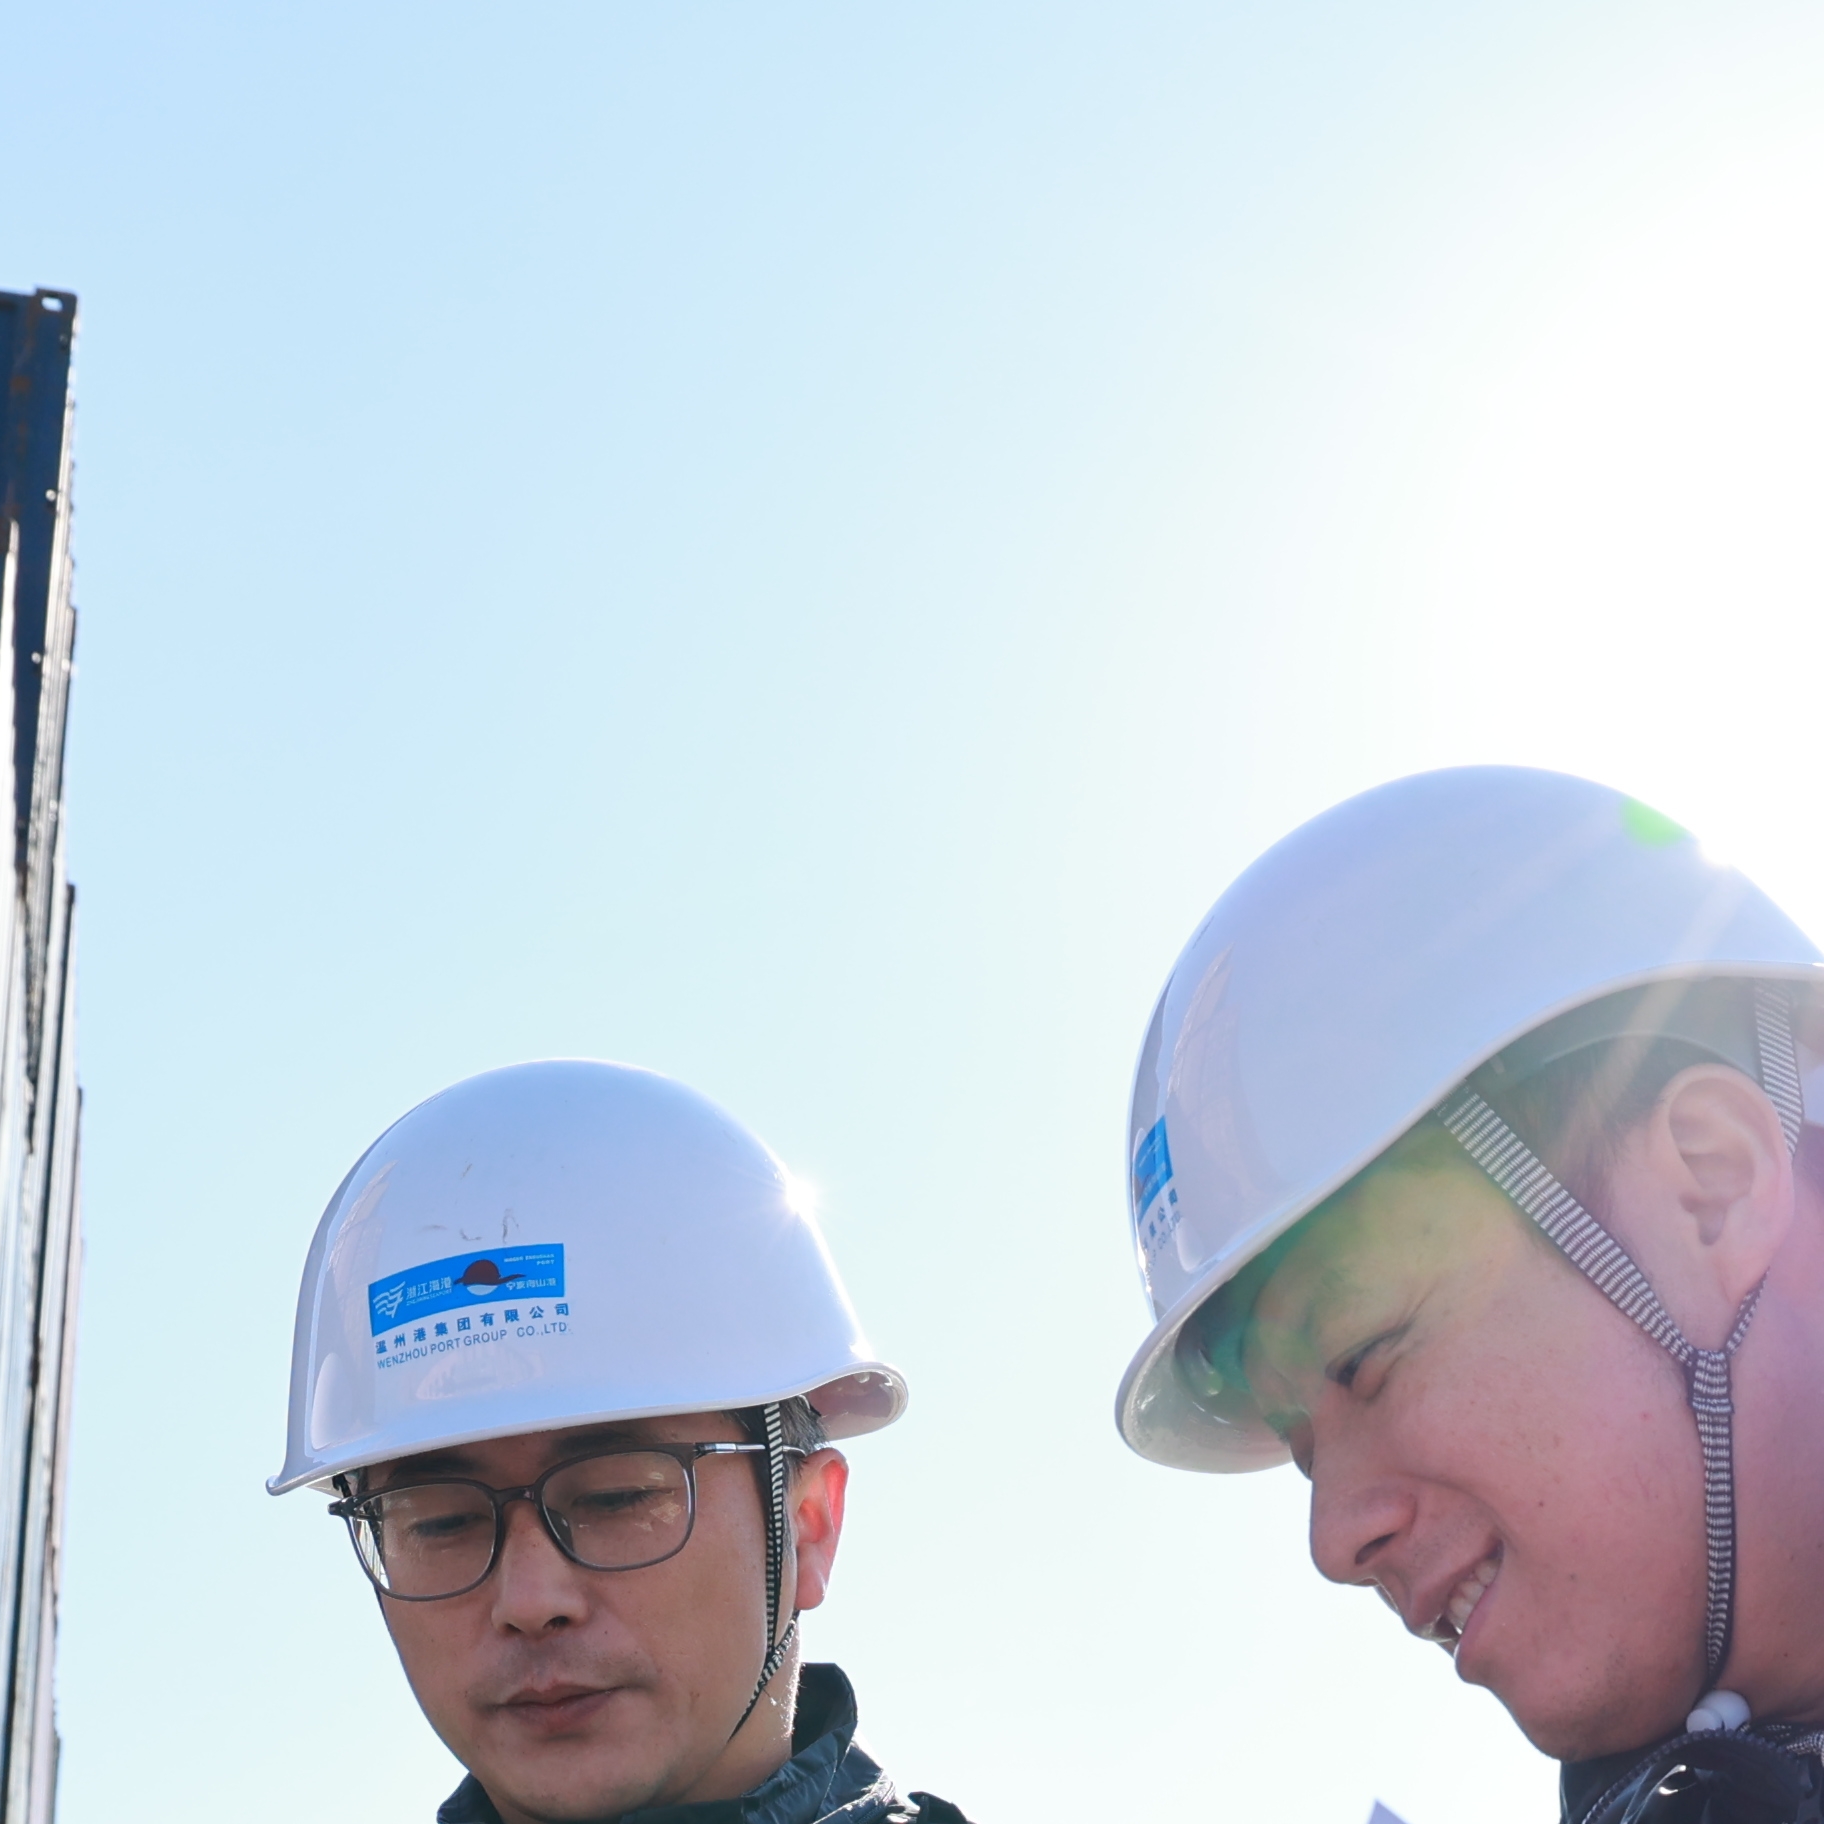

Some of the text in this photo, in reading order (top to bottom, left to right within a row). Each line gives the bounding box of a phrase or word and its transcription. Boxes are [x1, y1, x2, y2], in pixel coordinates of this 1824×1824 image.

[375, 1303, 570, 1354] 温州港集团有限公司
[376, 1345, 428, 1370] WENZHOU
[430, 1337, 461, 1355] PORT
[463, 1329, 508, 1347] GROUP
